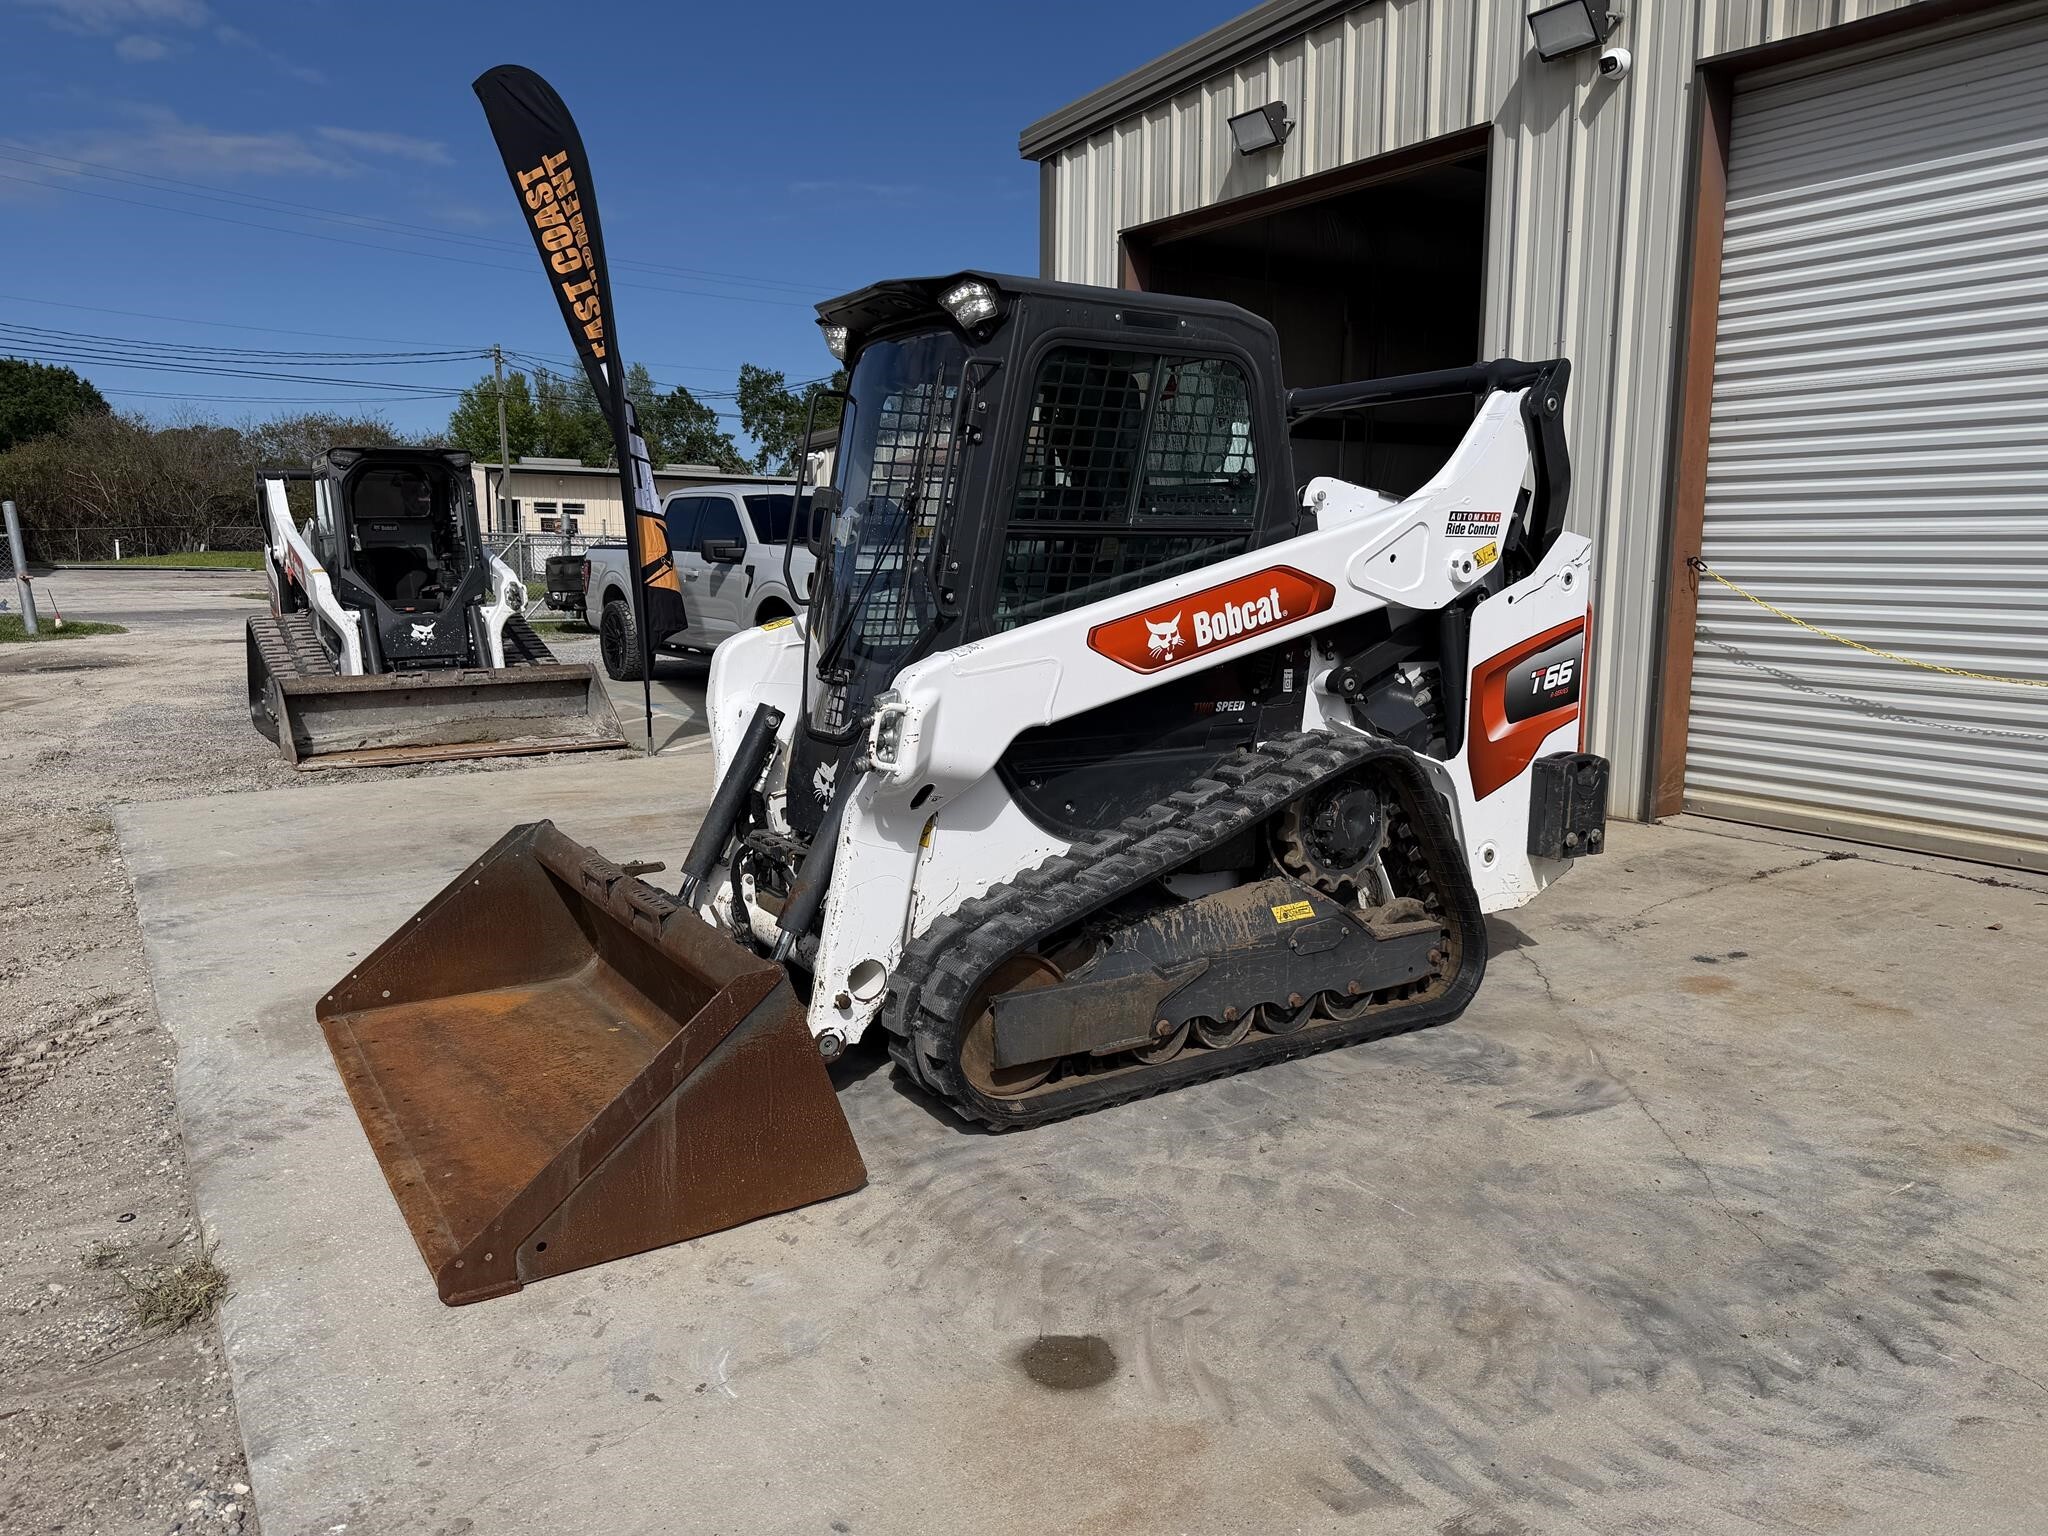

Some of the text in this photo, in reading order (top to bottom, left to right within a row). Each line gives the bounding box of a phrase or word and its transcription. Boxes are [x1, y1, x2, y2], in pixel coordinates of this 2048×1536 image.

[517, 166, 583, 274] COAST
[1450, 512, 1500, 521] AUTOMATIC
[1446, 523, 1500, 536] Ride Control
[1193, 587, 1281, 648] Bobcat
[1530, 659, 1575, 695] T66
[1215, 701, 1246, 712] SPEED
